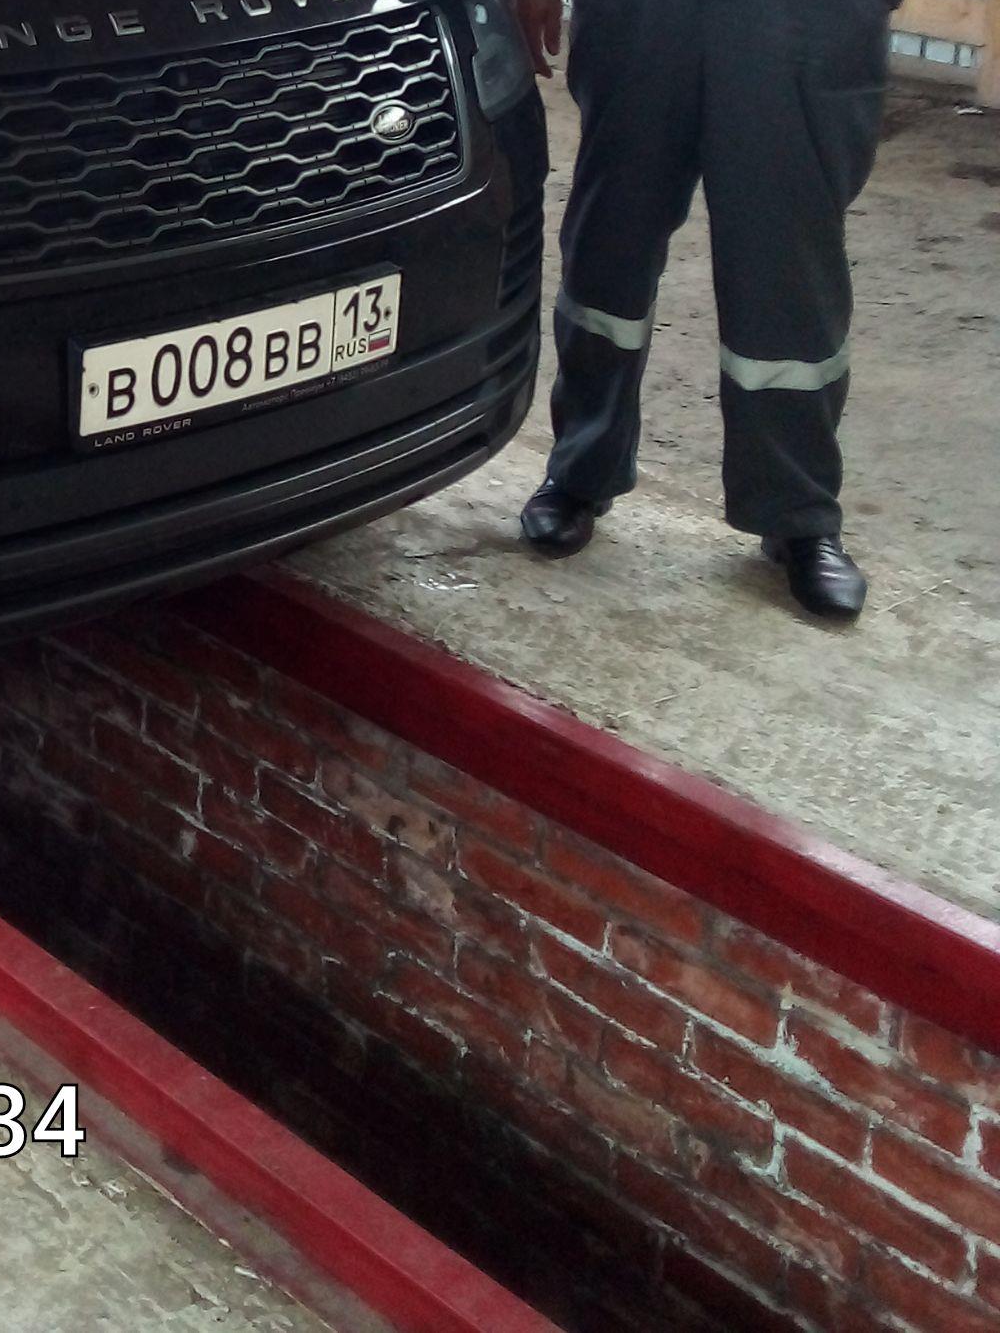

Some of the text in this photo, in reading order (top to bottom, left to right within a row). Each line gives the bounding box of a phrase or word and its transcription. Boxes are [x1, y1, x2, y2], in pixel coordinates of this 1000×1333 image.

[343, 284, 383, 338] 13
[334, 337, 367, 363] RUS
[94, 418, 192, 447] LAND ROVER
